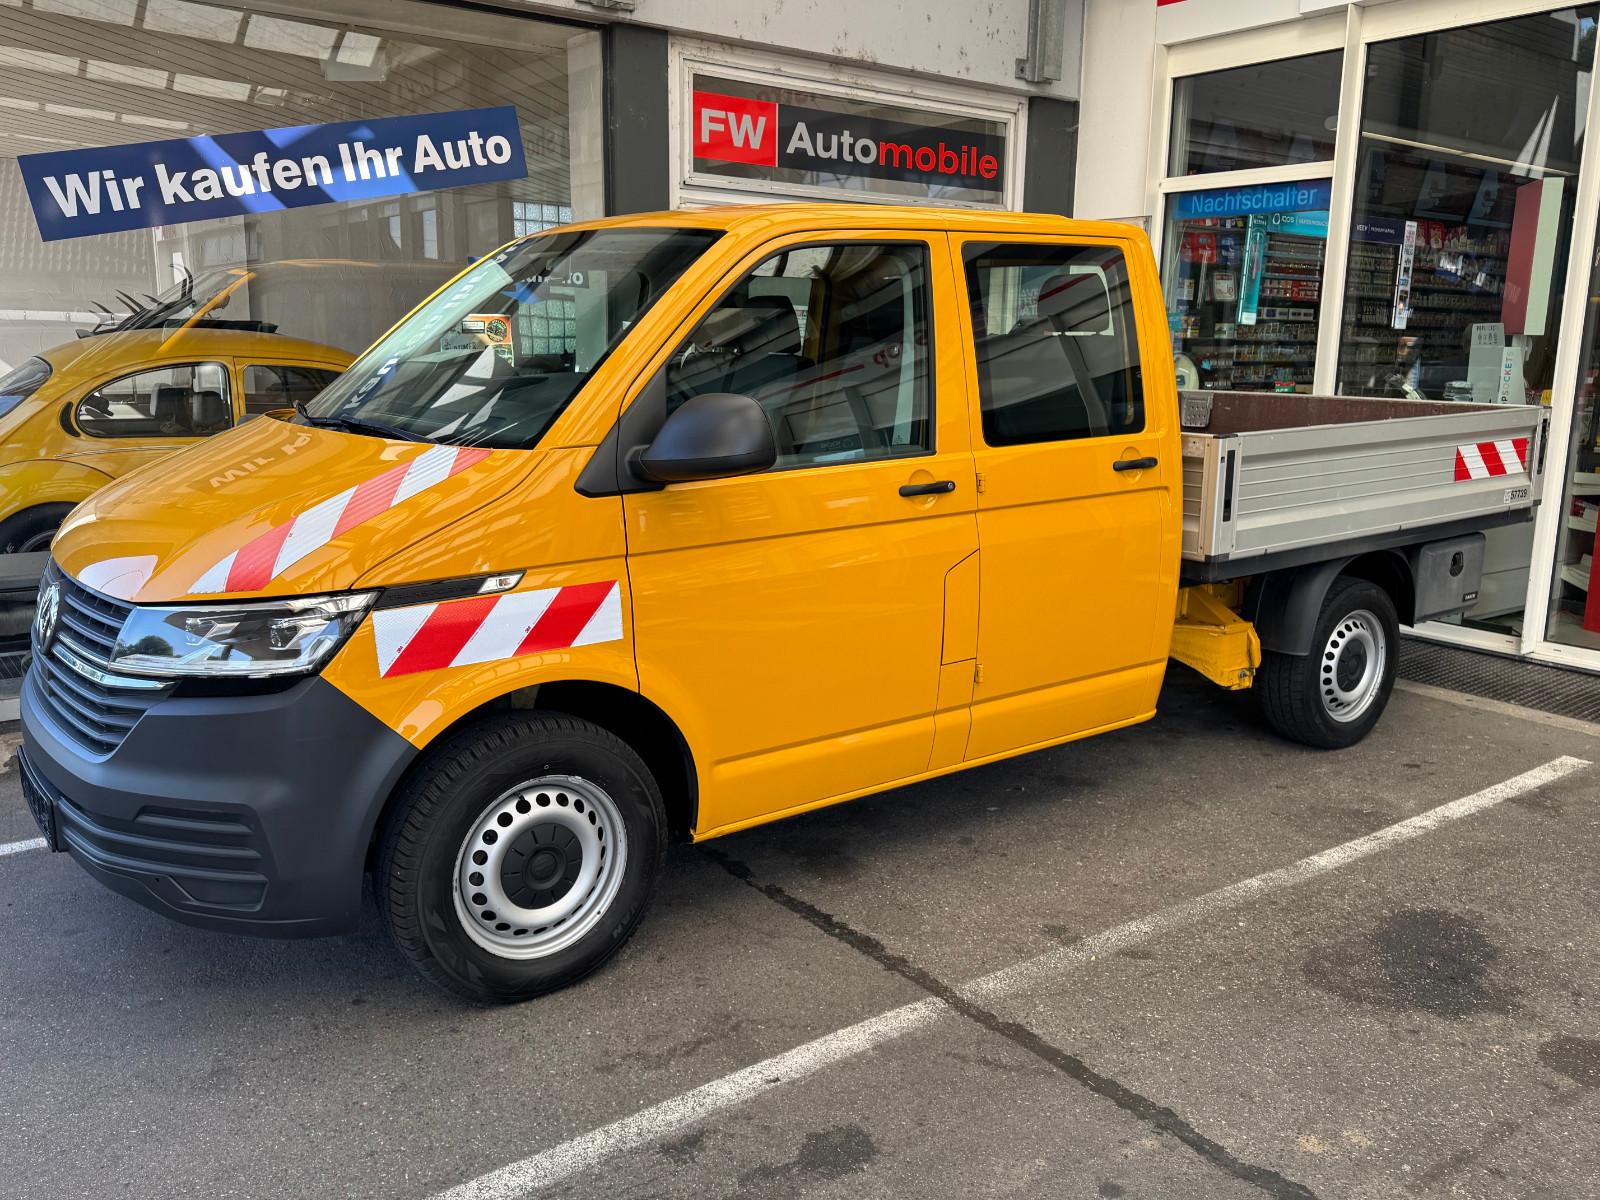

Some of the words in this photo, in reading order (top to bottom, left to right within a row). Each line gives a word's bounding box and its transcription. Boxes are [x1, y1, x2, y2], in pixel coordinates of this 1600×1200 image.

[43, 170, 144, 218] Wir
[154, 150, 334, 205] kaufen
[338, 141, 403, 183] Ihr
[414, 129, 512, 174] Auto
[701, 107, 767, 150] FW
[786, 121, 998, 180] Automobile
[1191, 187, 1318, 214] Nachtschalter
[1501, 351, 1514, 403] PSOCKETS
